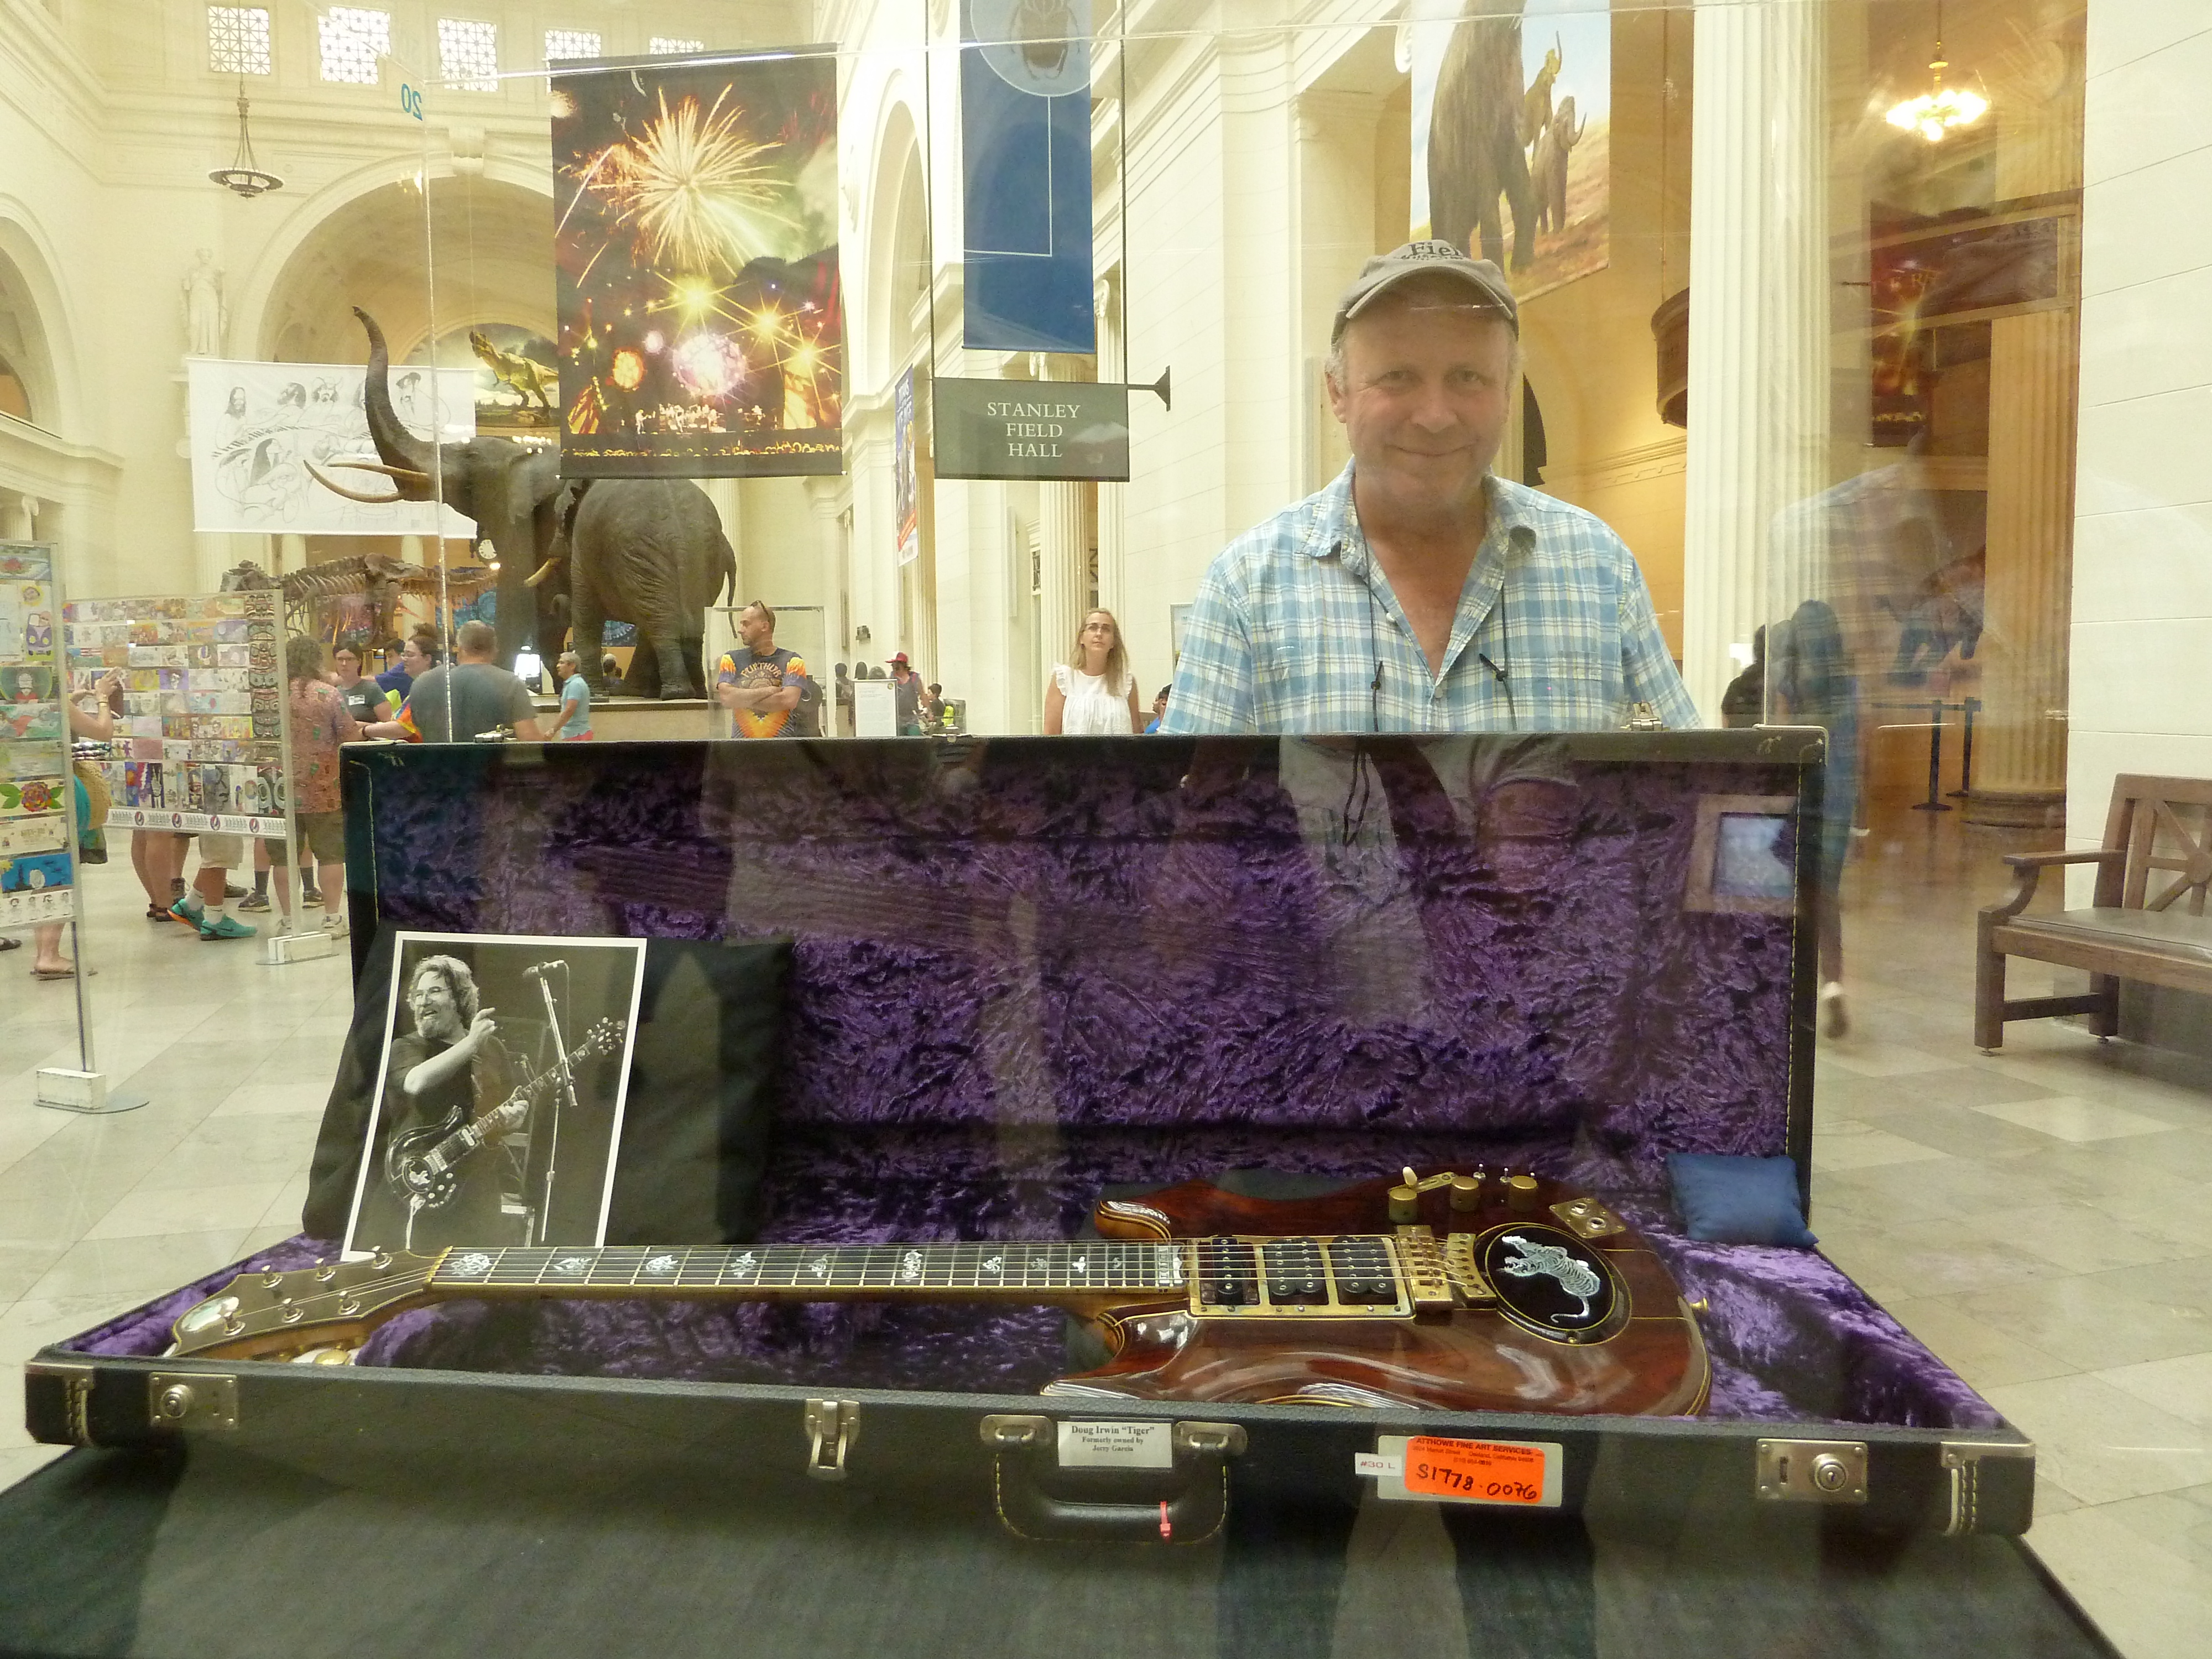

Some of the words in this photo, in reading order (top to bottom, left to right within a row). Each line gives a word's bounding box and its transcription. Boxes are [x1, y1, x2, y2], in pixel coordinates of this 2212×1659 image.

[987, 401, 1081, 418] STANLEY
[1005, 422, 1063, 437] FIELD
[1008, 443, 1063, 457] HALL
[1071, 1425, 1094, 1435] Doug
[1095, 1425, 1119, 1434] Irwin
[1456, 1441, 1473, 1449] FINE
[1486, 1481, 1537, 1500] 0076
